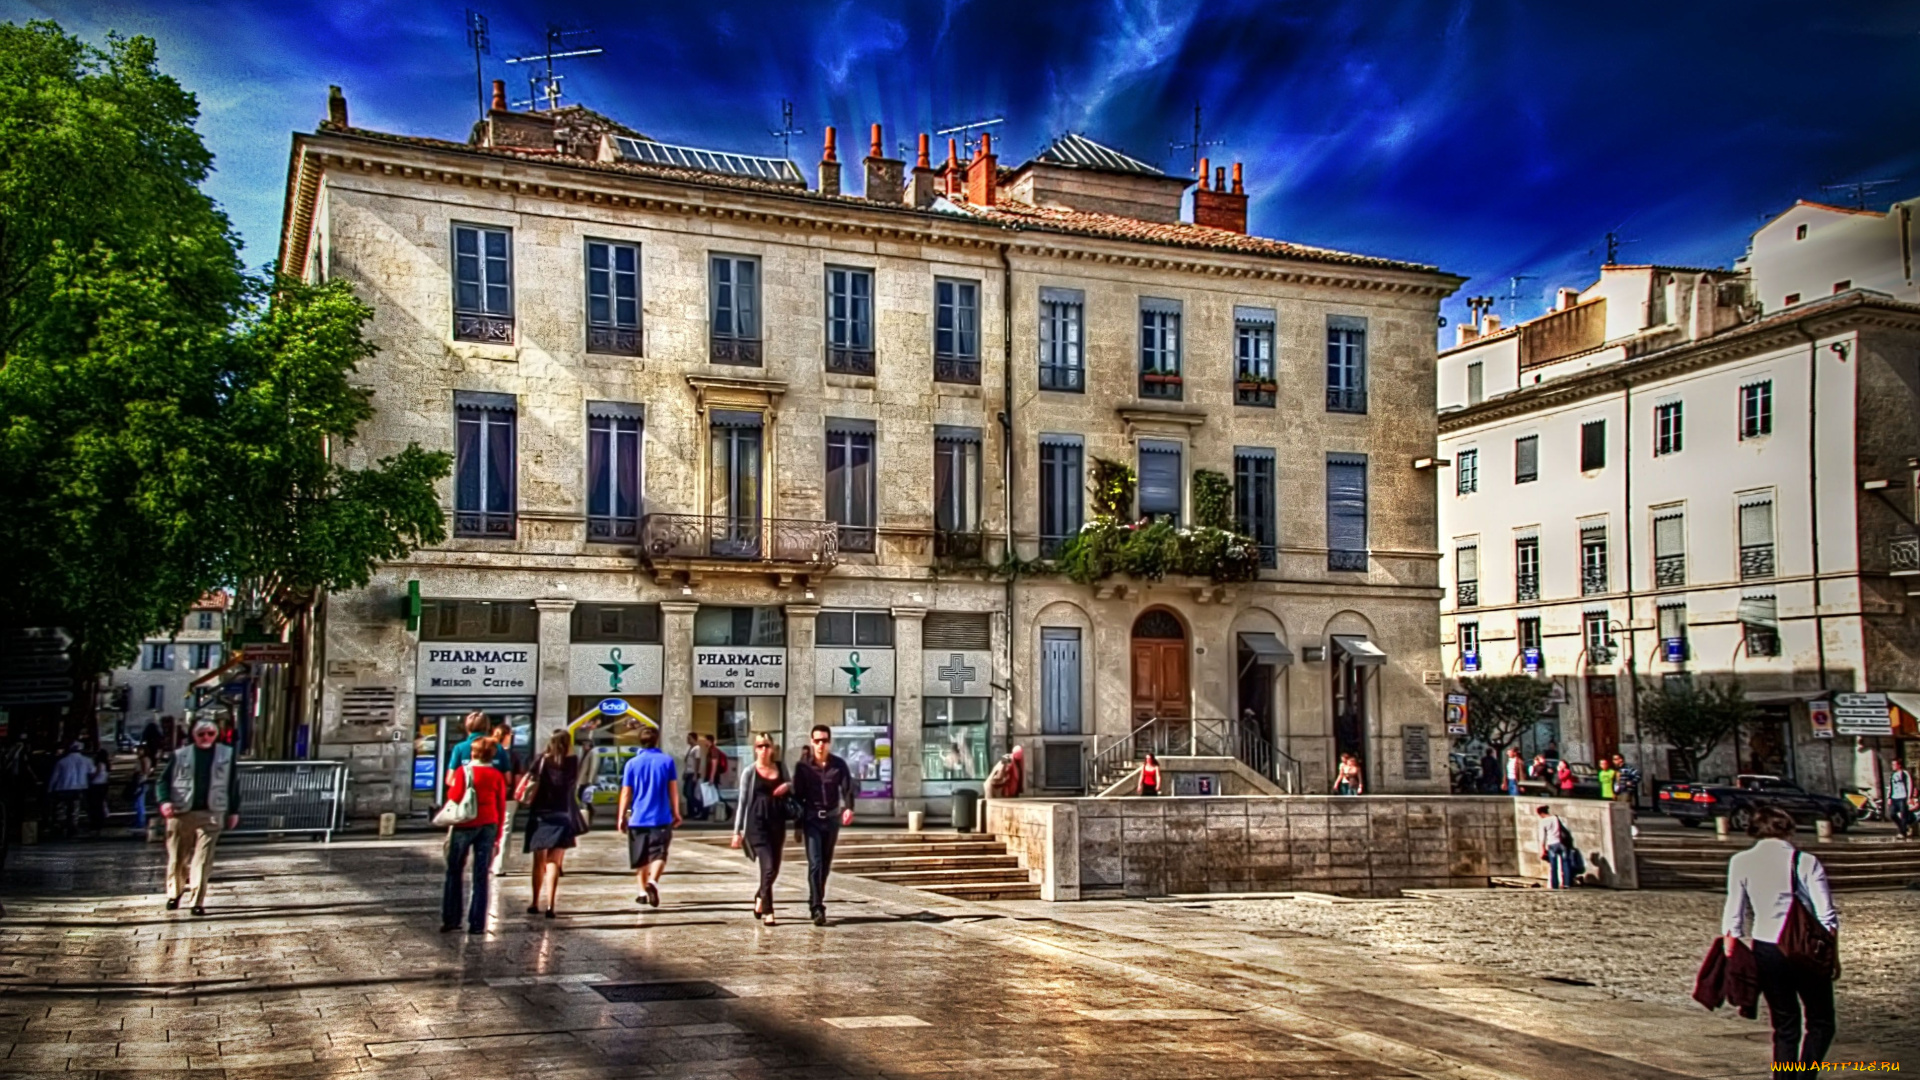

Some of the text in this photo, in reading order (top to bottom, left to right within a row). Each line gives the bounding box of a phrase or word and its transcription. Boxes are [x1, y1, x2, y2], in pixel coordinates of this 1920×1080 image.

[429, 650, 528, 663] PHARMACIE
[697, 653, 783, 666] PHARMACIE
[462, 665, 496, 675] de la
[725, 668, 755, 677] de la
[431, 677, 524, 687] Maison Carrée
[700, 679, 780, 689] Maison Carrée
[602, 702, 626, 711] Scholl
